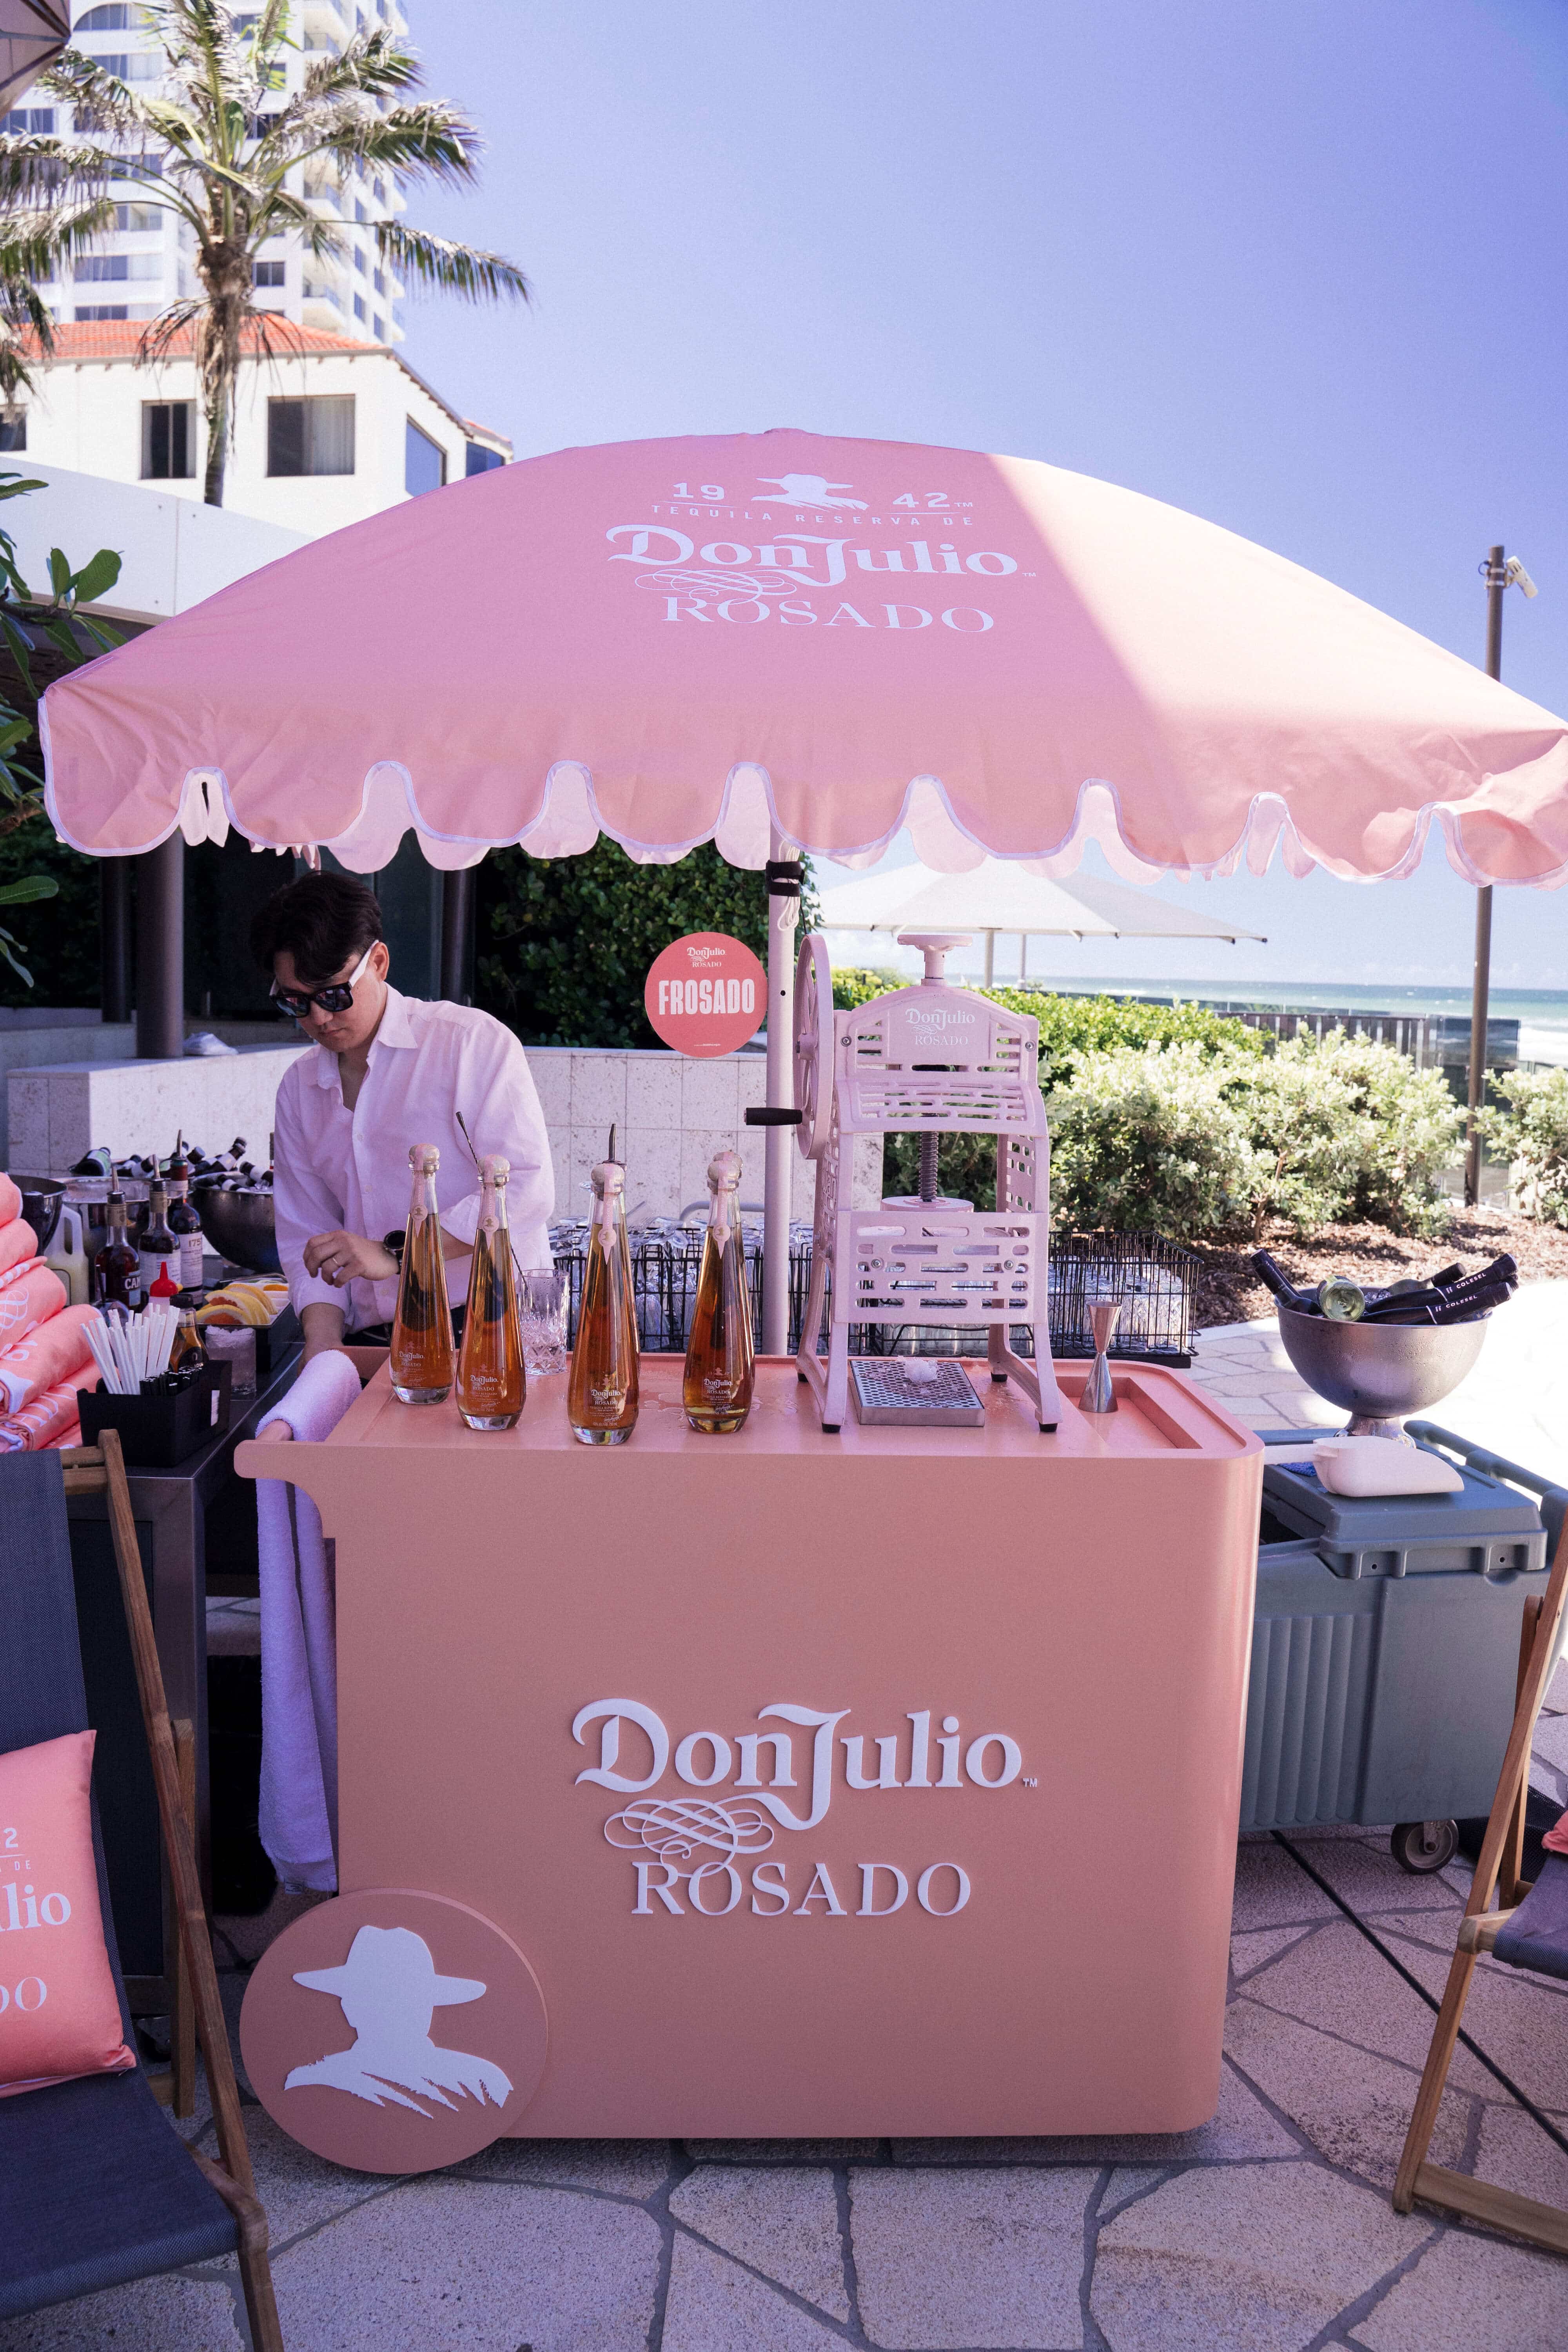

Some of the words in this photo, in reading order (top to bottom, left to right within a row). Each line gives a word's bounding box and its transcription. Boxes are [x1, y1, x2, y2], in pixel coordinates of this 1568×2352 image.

[673, 483, 724, 500] 19
[892, 492, 950, 508] 42
[652, 505, 772, 521] TEQUILA
[795, 514, 920, 525] RESERVA
[943, 517, 973, 526] DE
[661, 596, 994, 633] ROSADO
[659, 978, 755, 1015] FROSADO
[914, 1035, 968, 1046] ROSADO
[1456, 1272, 1486, 1289] COLESEL
[1446, 1295, 1477, 1308] COLESEL
[14, 1860, 31, 1871] DE
[631, 1861, 971, 1916] ROSADO
[0, 1882, 71, 1933] lio
